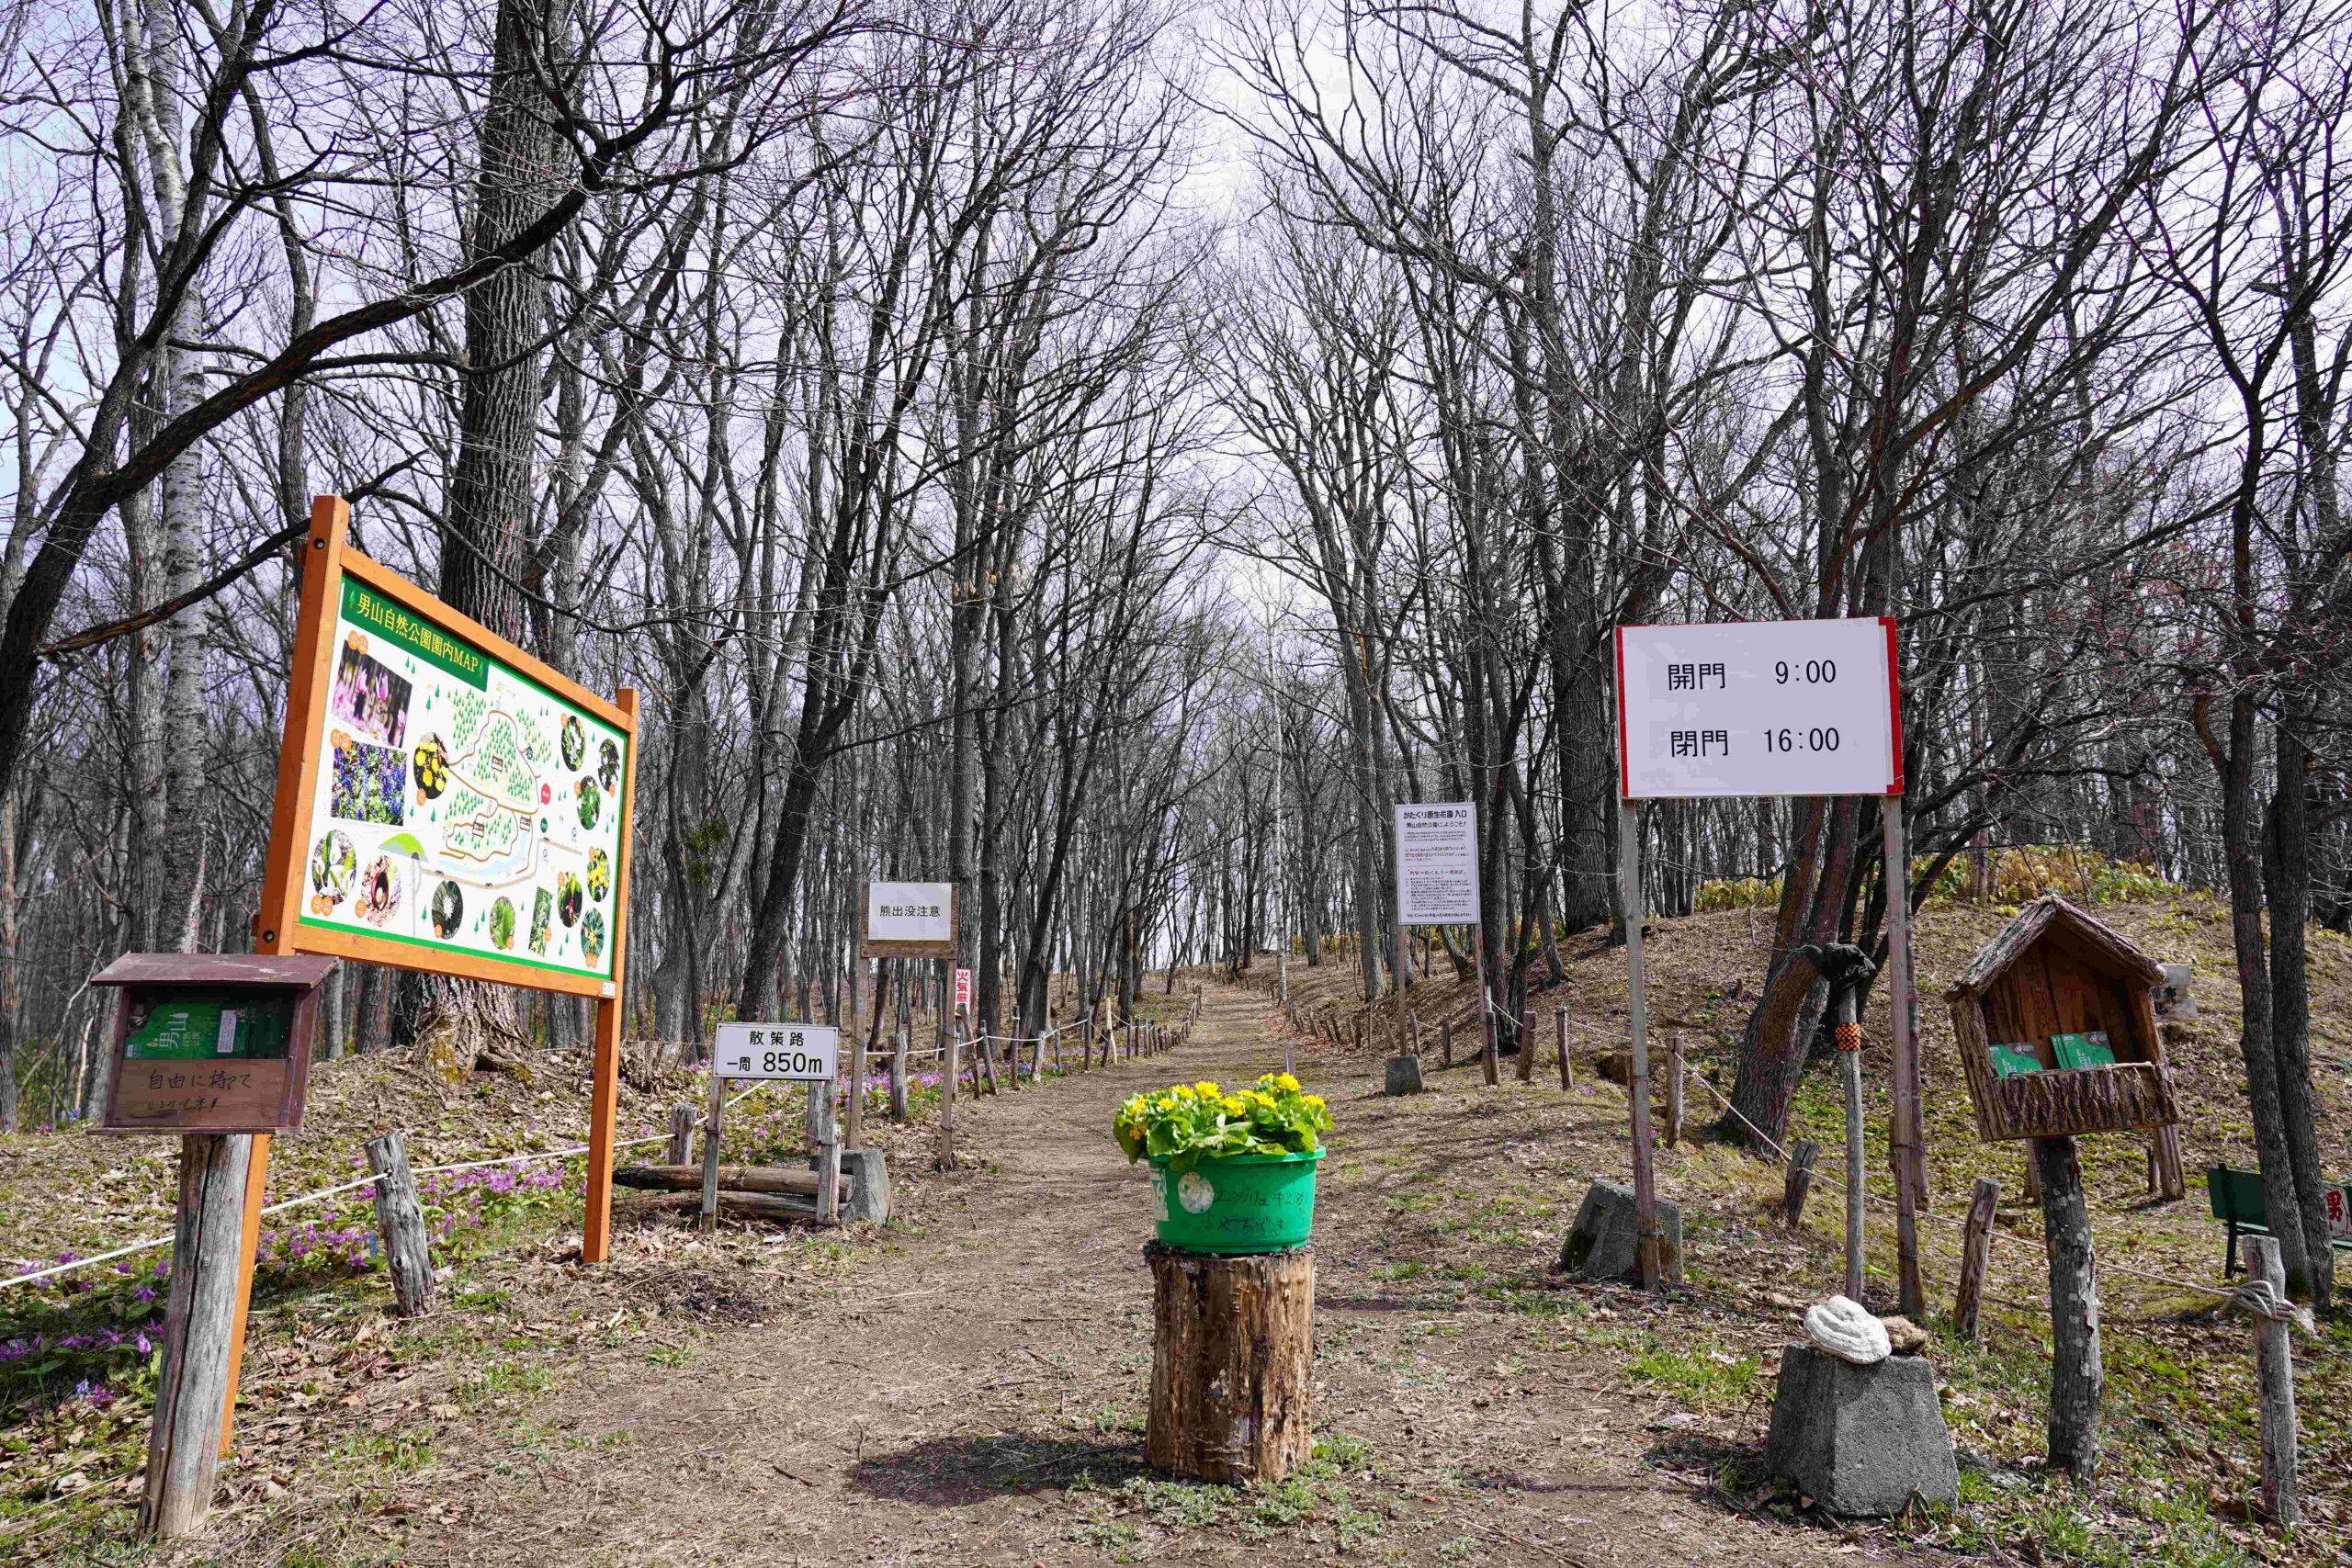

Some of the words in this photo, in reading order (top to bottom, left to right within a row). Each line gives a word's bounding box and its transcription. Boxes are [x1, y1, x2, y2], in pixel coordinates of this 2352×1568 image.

[357, 592, 479, 672] 男山自然公園園内MAP
[1668, 662, 1725, 691] 開門
[1775, 660, 1837, 685] 9:00
[1670, 729, 1729, 758] 閉門
[1764, 727, 1840, 753] 16:00
[1454, 809, 1467, 818] 入口
[879, 905, 941, 918] 熊出没注意
[956, 971, 968, 1002] 火気厳
[749, 1030, 805, 1047] 散策路
[727, 1056, 751, 1072] 一周
[763, 1051, 822, 1074] 850m
